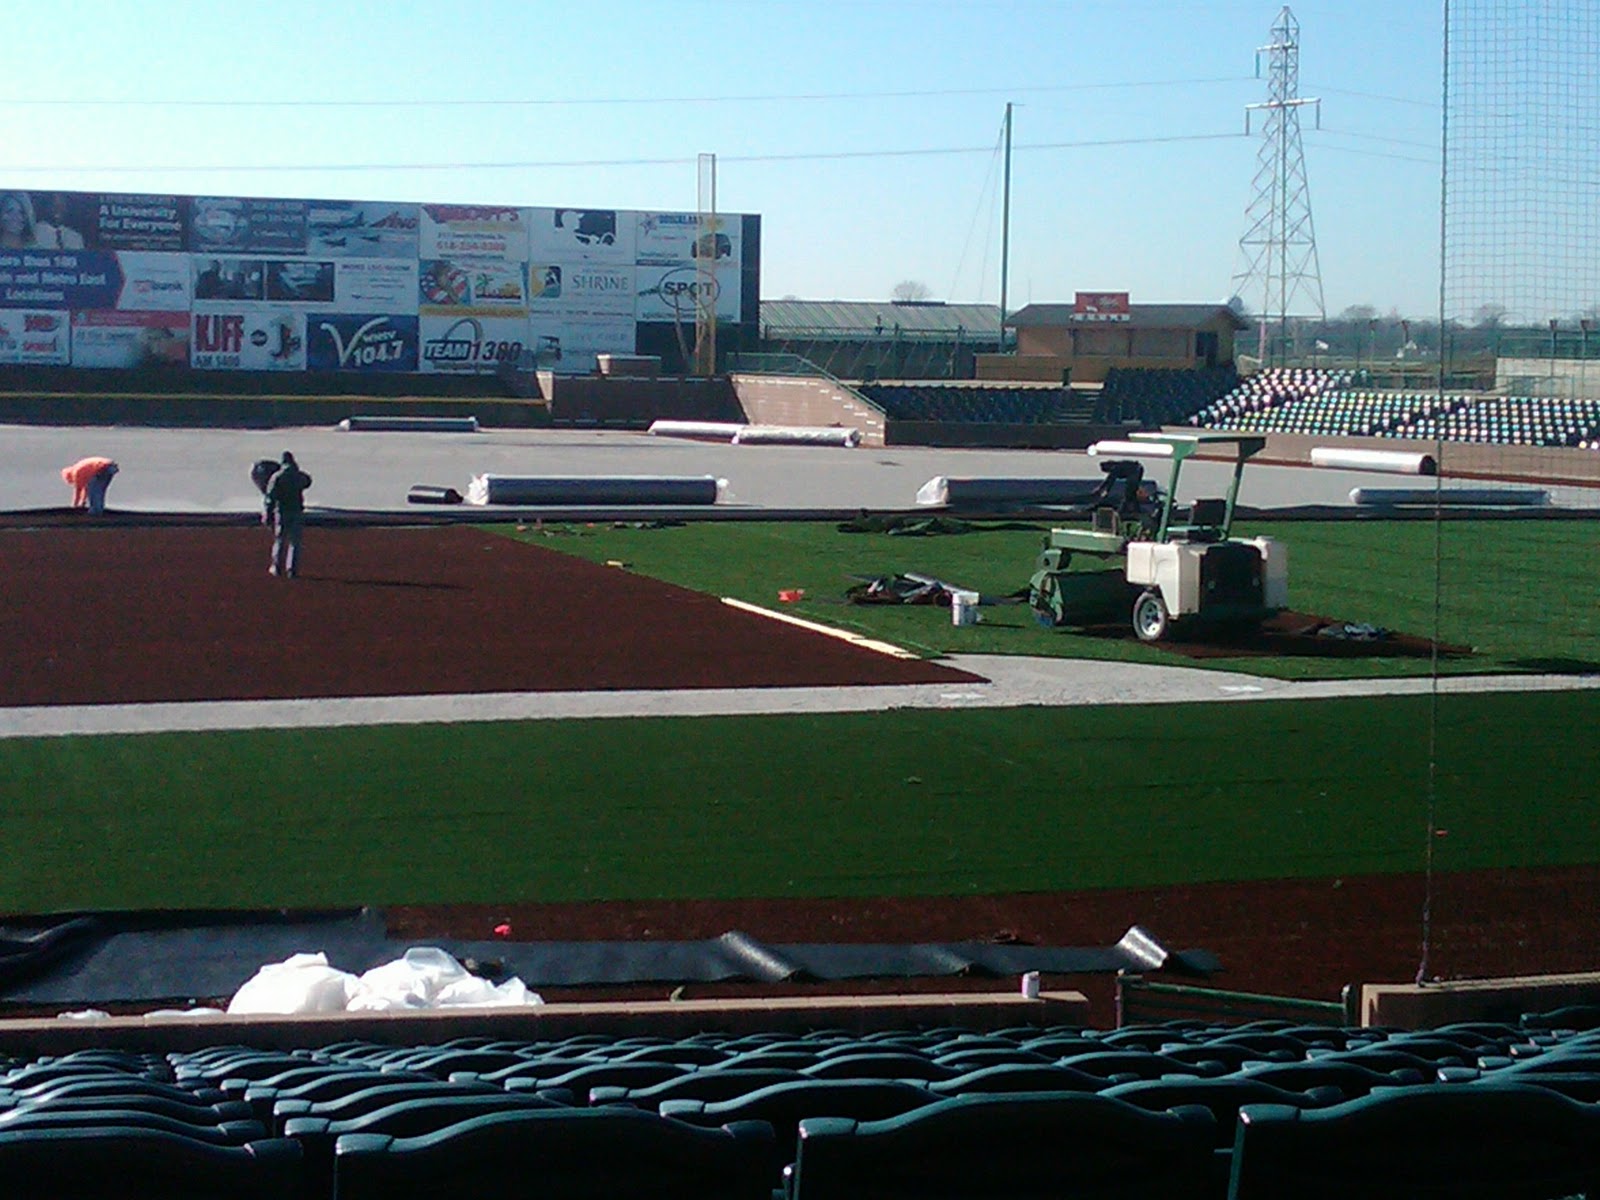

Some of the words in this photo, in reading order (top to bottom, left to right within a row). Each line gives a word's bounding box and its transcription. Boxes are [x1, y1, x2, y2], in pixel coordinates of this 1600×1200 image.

[99, 204, 109, 215] A
[111, 205, 176, 220] University
[572, 275, 629, 291] SHRINE
[664, 282, 714, 297] SPOT
[353, 340, 404, 367] 104.7
[425, 342, 469, 359] TEAM
[472, 340, 523, 362] 1380
